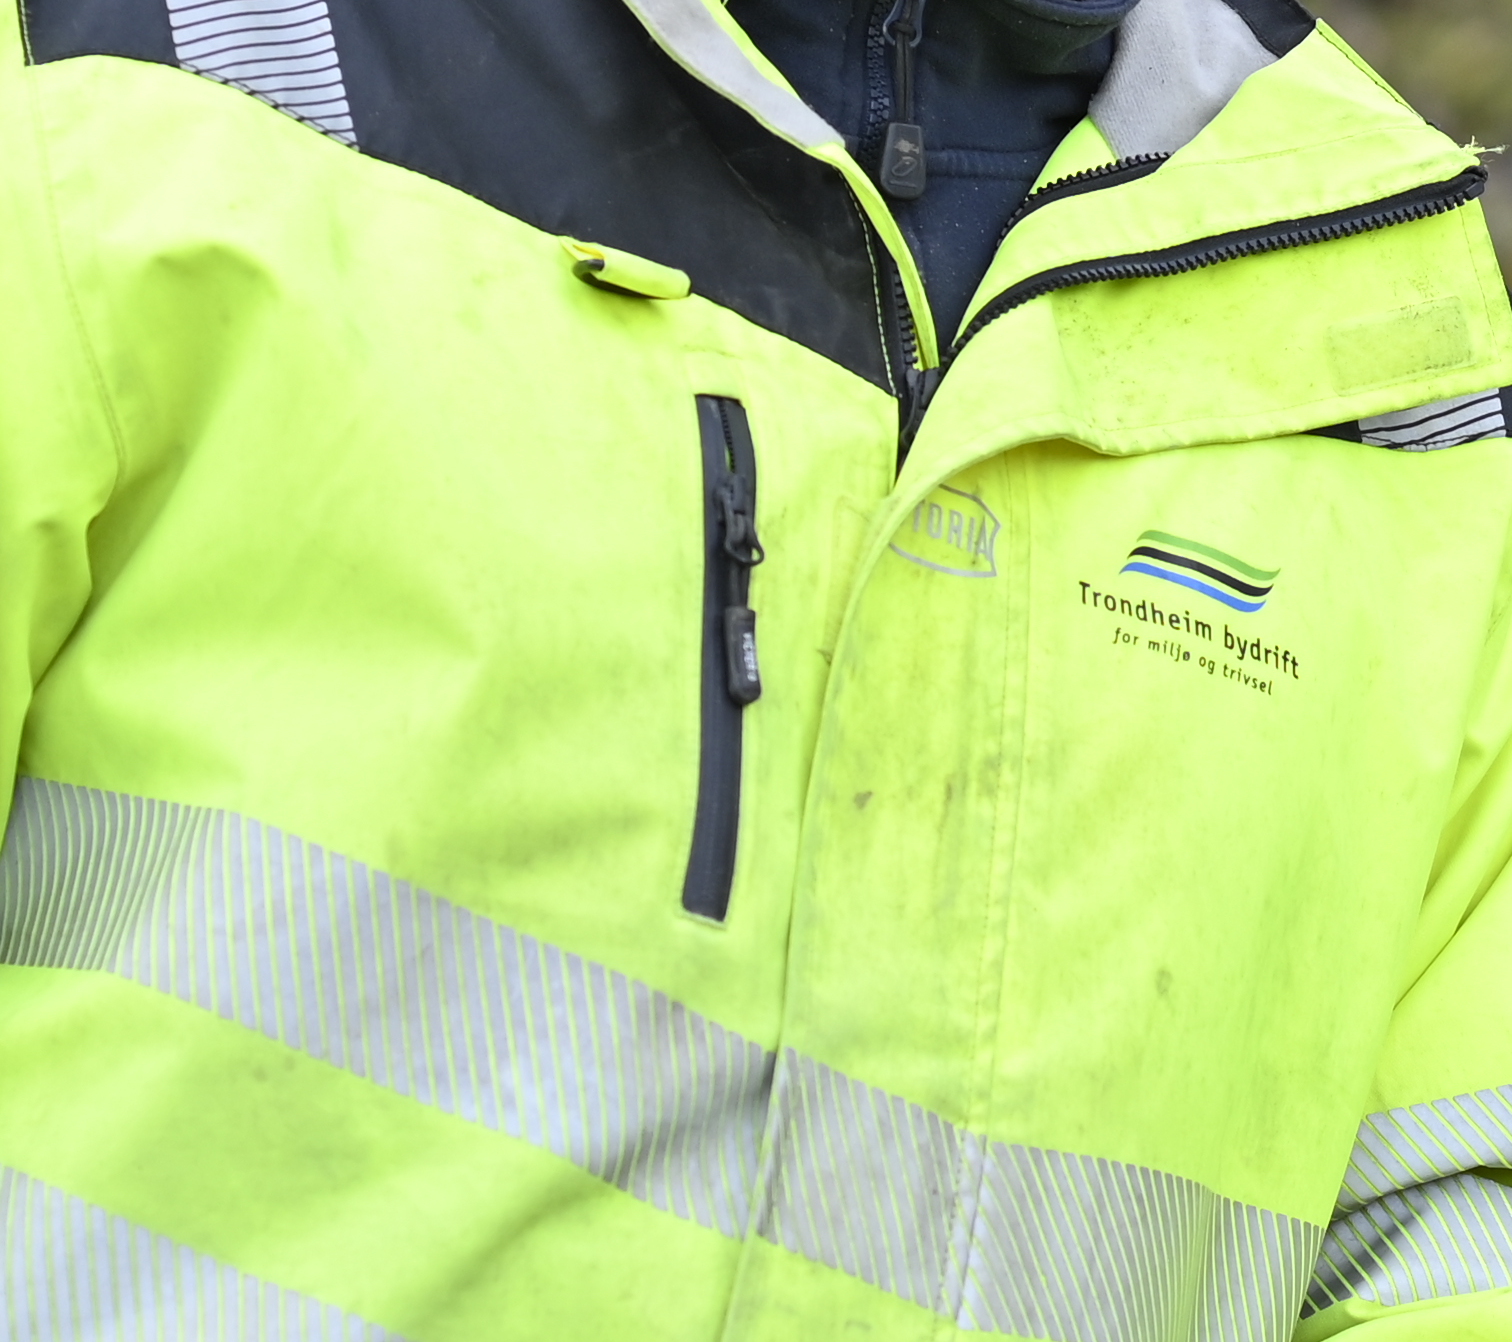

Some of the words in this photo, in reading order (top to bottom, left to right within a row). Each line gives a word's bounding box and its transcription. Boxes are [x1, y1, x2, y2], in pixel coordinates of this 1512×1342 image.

[912, 498, 991, 562] TORIA
[1078, 580, 1213, 641] Trondheim
[1223, 624, 1300, 679] bydrift
[1112, 627, 1139, 644] for
[1148, 639, 1191, 662] miljø
[1198, 656, 1216, 674] og
[1223, 663, 1273, 696] trivsel
